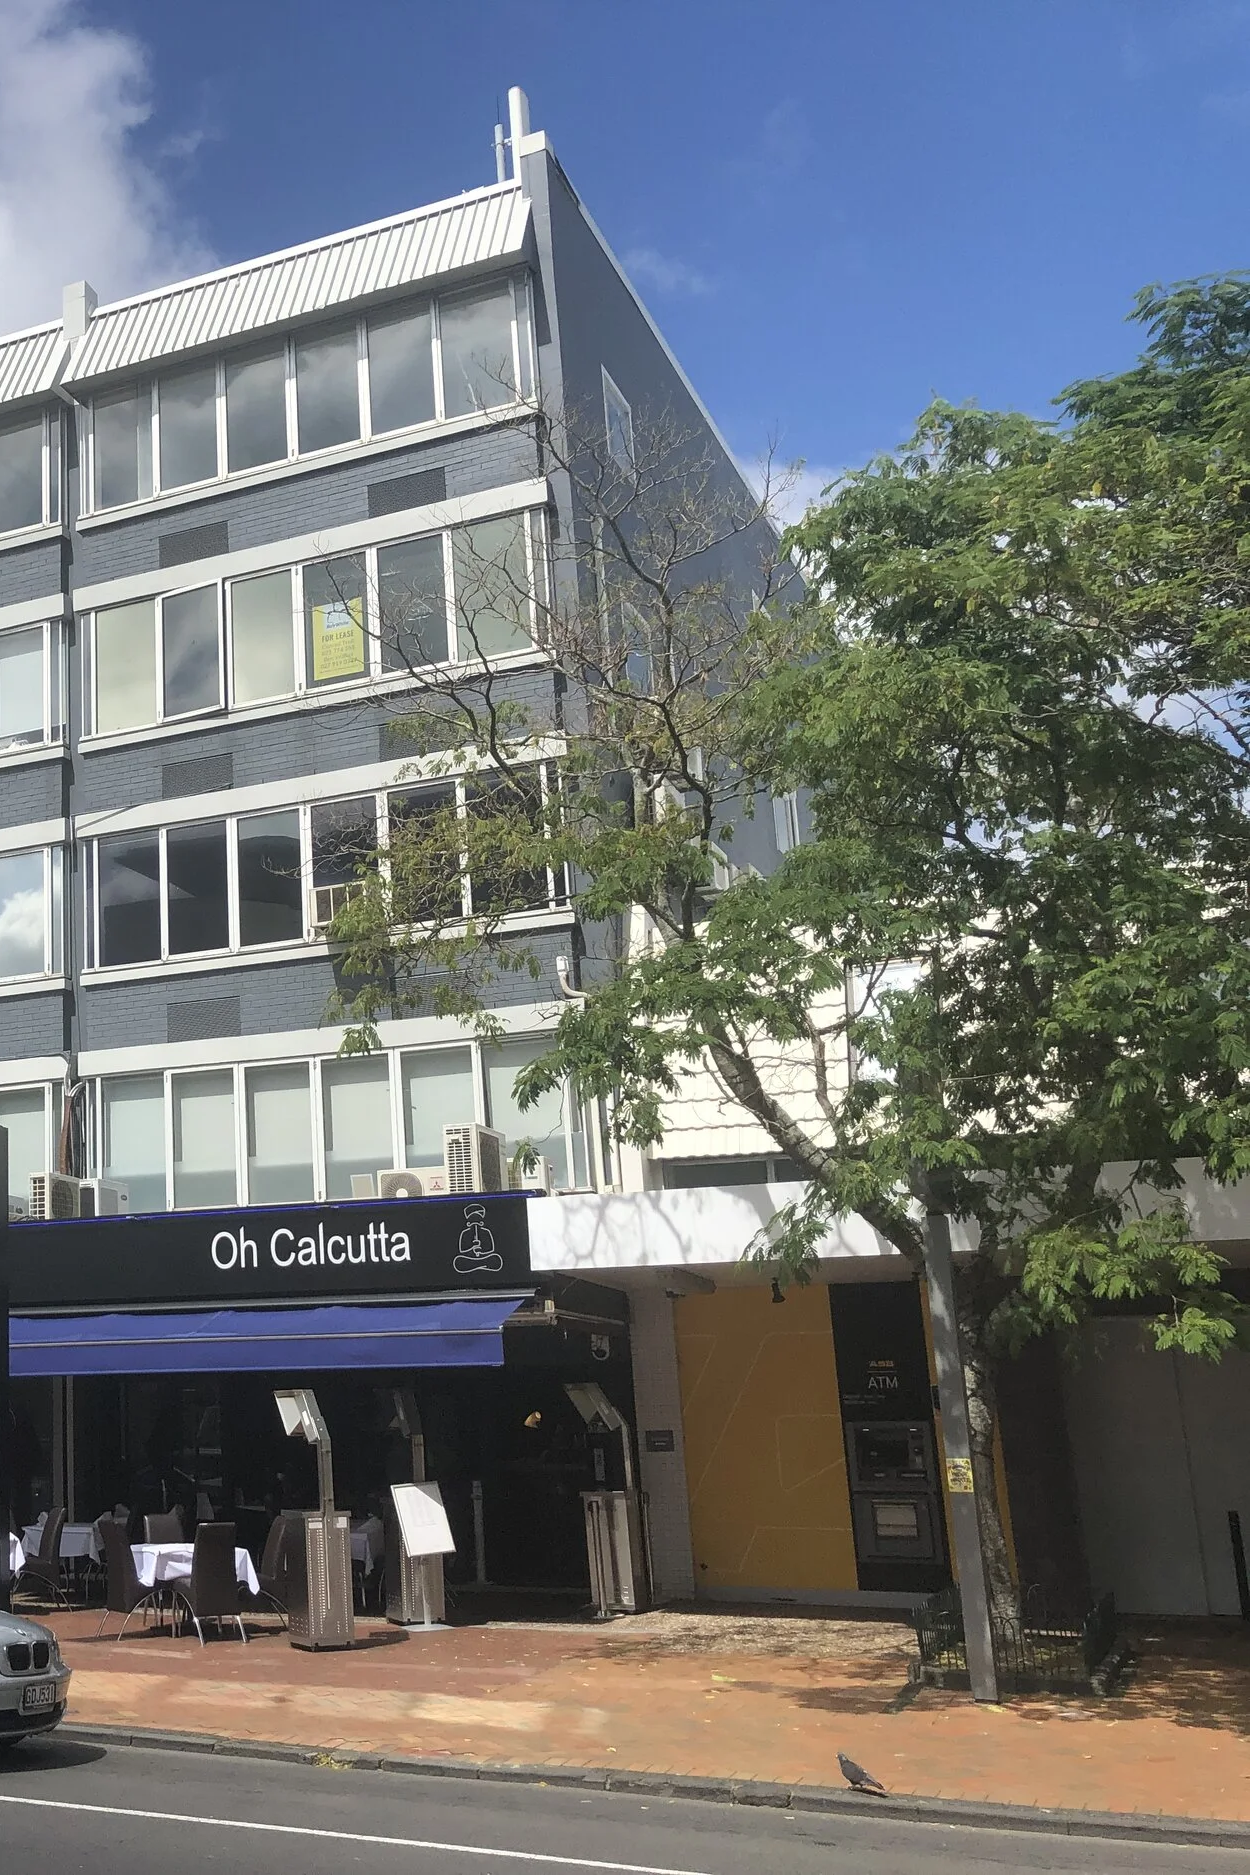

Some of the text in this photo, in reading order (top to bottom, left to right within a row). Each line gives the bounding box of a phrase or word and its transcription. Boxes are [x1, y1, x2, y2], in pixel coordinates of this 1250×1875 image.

[336, 629, 354, 640] LEASE
[211, 1221, 411, 1270] Oh Calcutta
[868, 1376, 899, 1389] ATM
